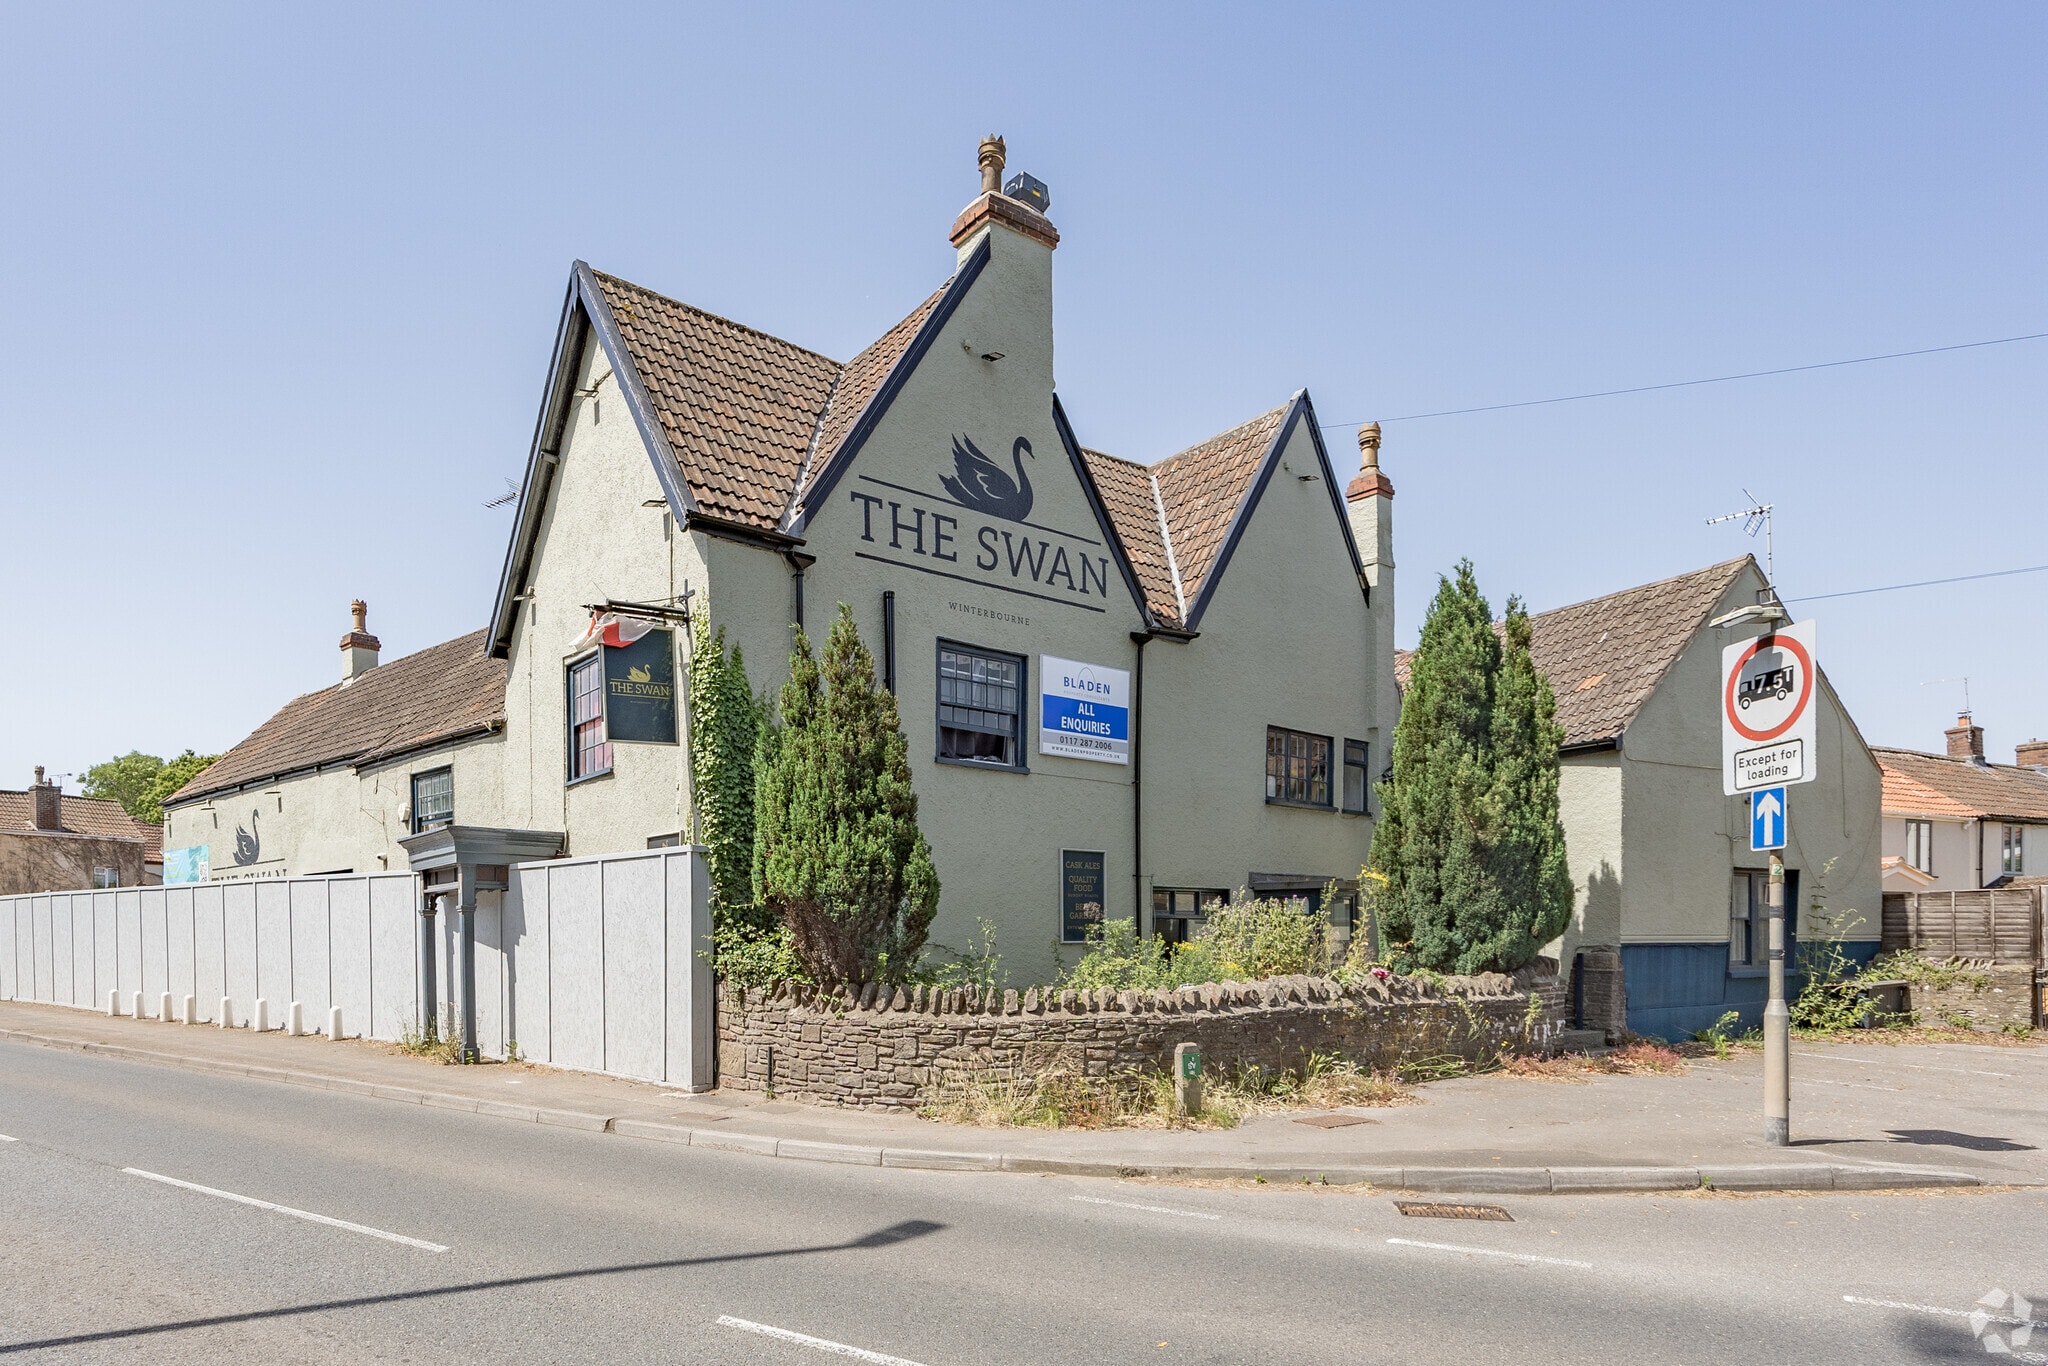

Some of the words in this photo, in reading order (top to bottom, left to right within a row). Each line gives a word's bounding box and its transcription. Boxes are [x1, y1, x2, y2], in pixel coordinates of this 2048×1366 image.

[850, 490, 957, 562] THE
[976, 526, 1108, 598] SWAN
[948, 602, 1030, 626] WINTERBOURNE
[610, 681, 633, 693] THE
[635, 684, 669, 696] SWAN
[1063, 676, 1110, 694] BLADEN
[1078, 702, 1095, 716] ALL
[1061, 716, 1110, 735] ENQUIRIES
[1059, 735, 1078, 746] 0117
[1080, 738, 1093, 748] 287
[1094, 740, 1112, 750] 2006
[1738, 751, 1776, 768] Except
[1780, 749, 1797, 760] for
[1747, 765, 1788, 780] loading
[1065, 861, 1083, 869] CASK
[1084, 862, 1100, 870] ALES
[1774, 864, 1782, 875] 2
[1068, 875, 1098, 884] QUALITY
[1073, 884, 1093, 892] FOOD
